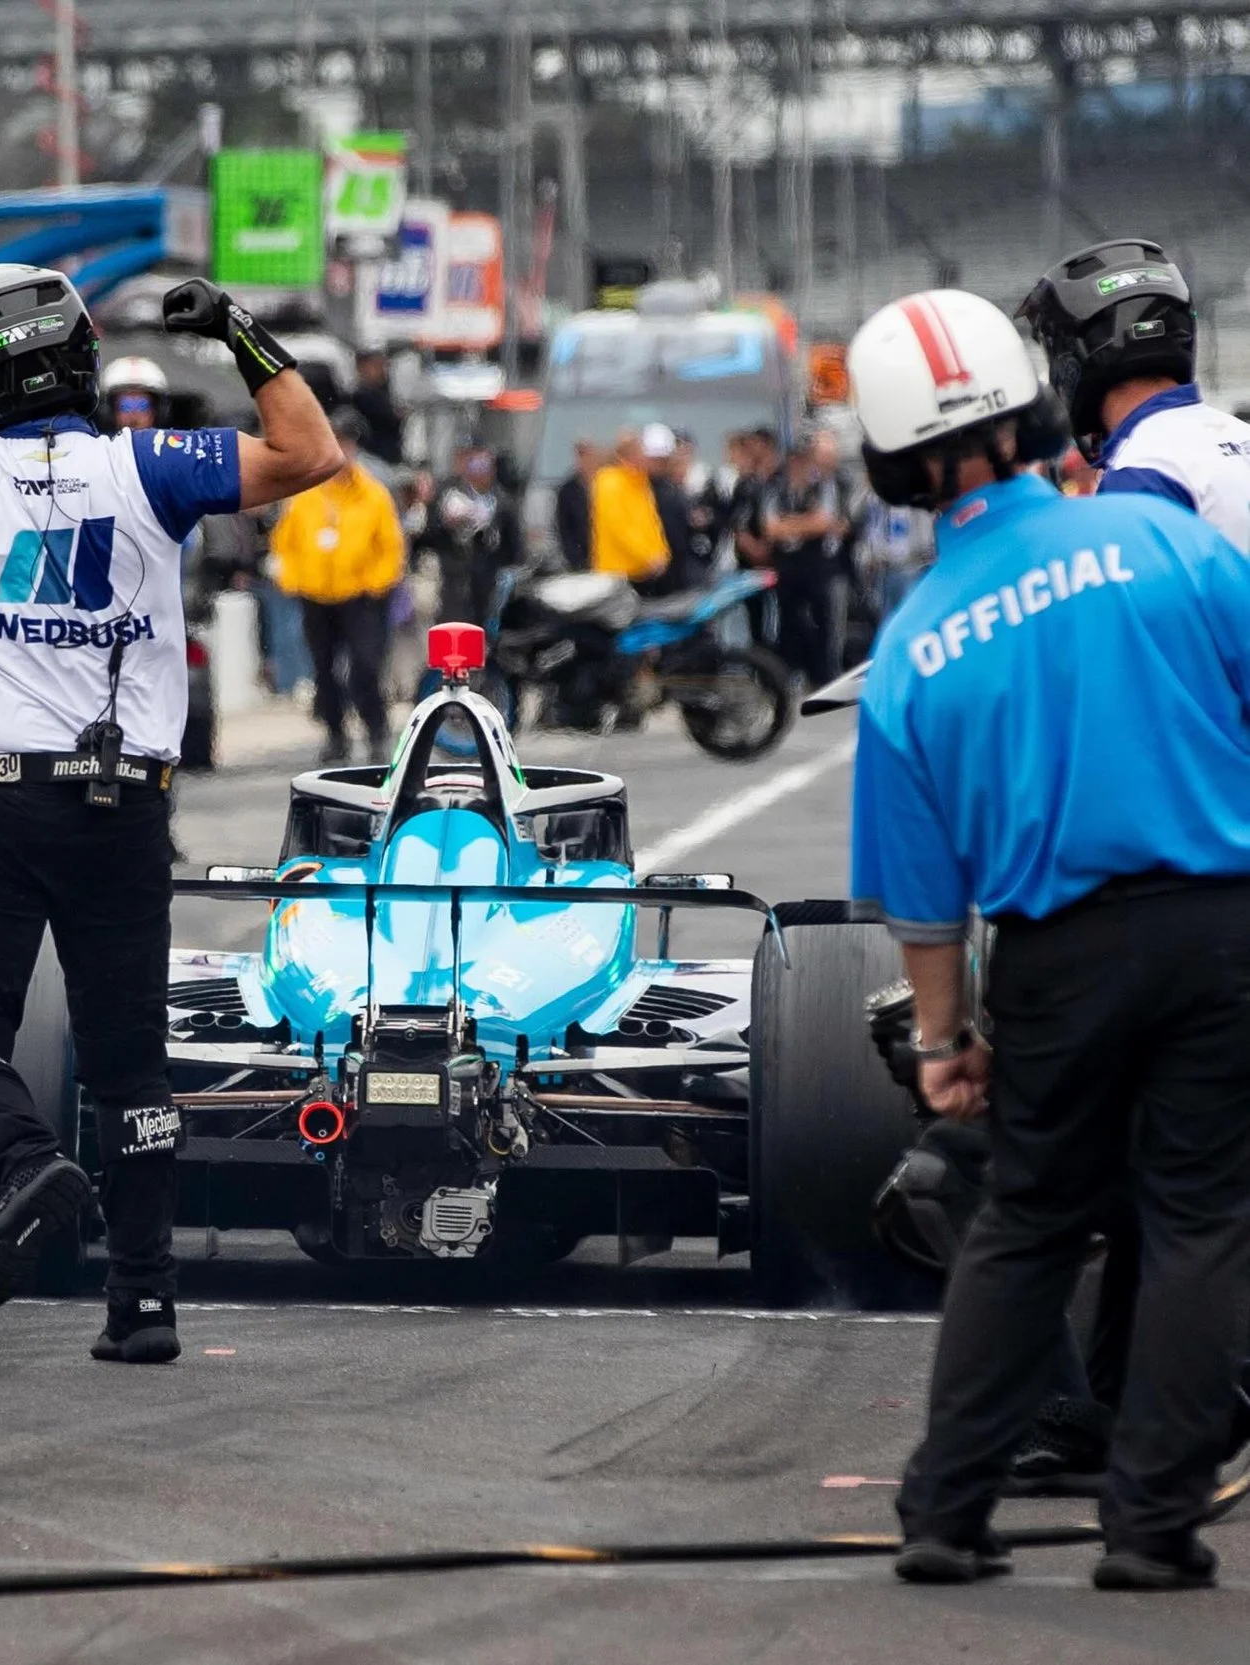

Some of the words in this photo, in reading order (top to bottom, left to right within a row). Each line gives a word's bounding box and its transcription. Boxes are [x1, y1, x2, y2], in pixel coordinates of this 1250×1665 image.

[907, 543, 1135, 678] OFFICIAL
[0, 754, 18, 778] 30
[53, 757, 148, 782] mechix.com
